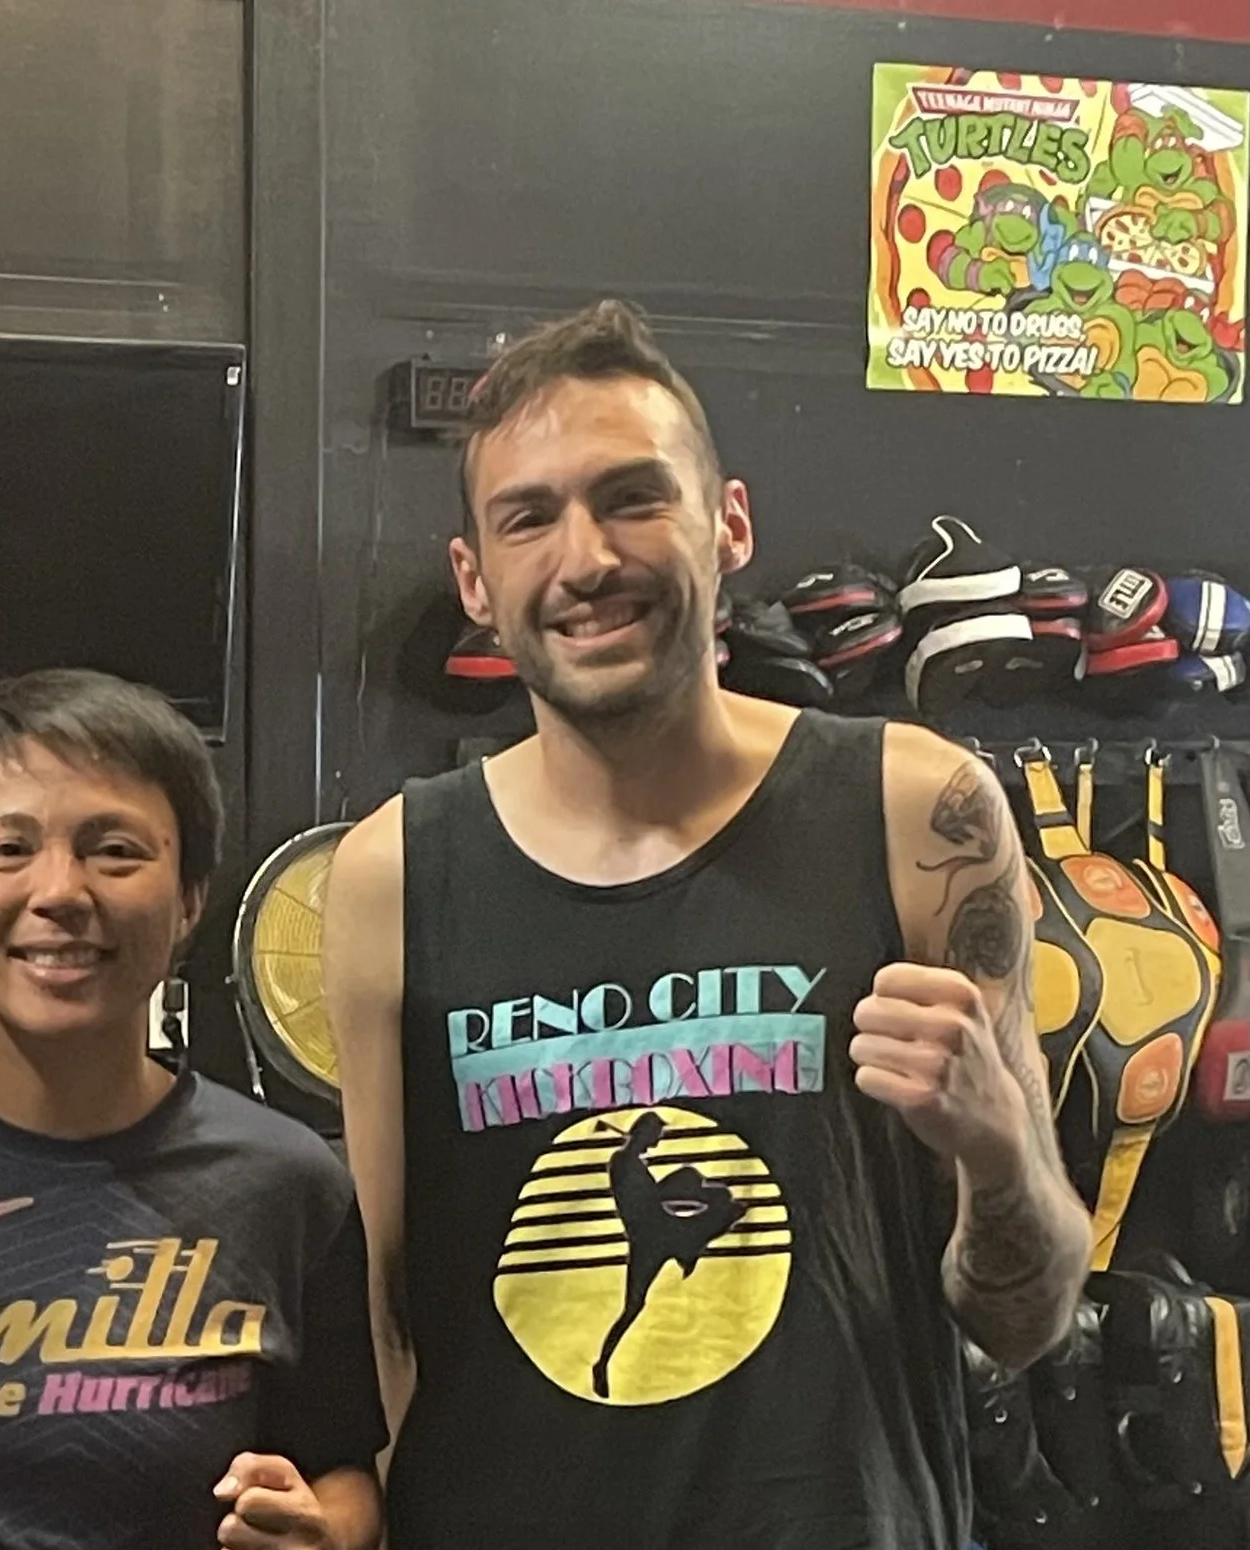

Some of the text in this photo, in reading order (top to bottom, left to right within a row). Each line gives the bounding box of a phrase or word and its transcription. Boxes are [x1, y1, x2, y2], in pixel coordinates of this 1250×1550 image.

[889, 111, 1091, 184] TURTLES
[888, 337, 1099, 375] SAY YES TO PIZZA!
[902, 305, 949, 333] SAY
[949, 311, 977, 335] NO
[978, 308, 1008, 336] TO
[447, 964, 827, 1055] RENO CITY
[462, 1040, 824, 1132] KICKBOXING
